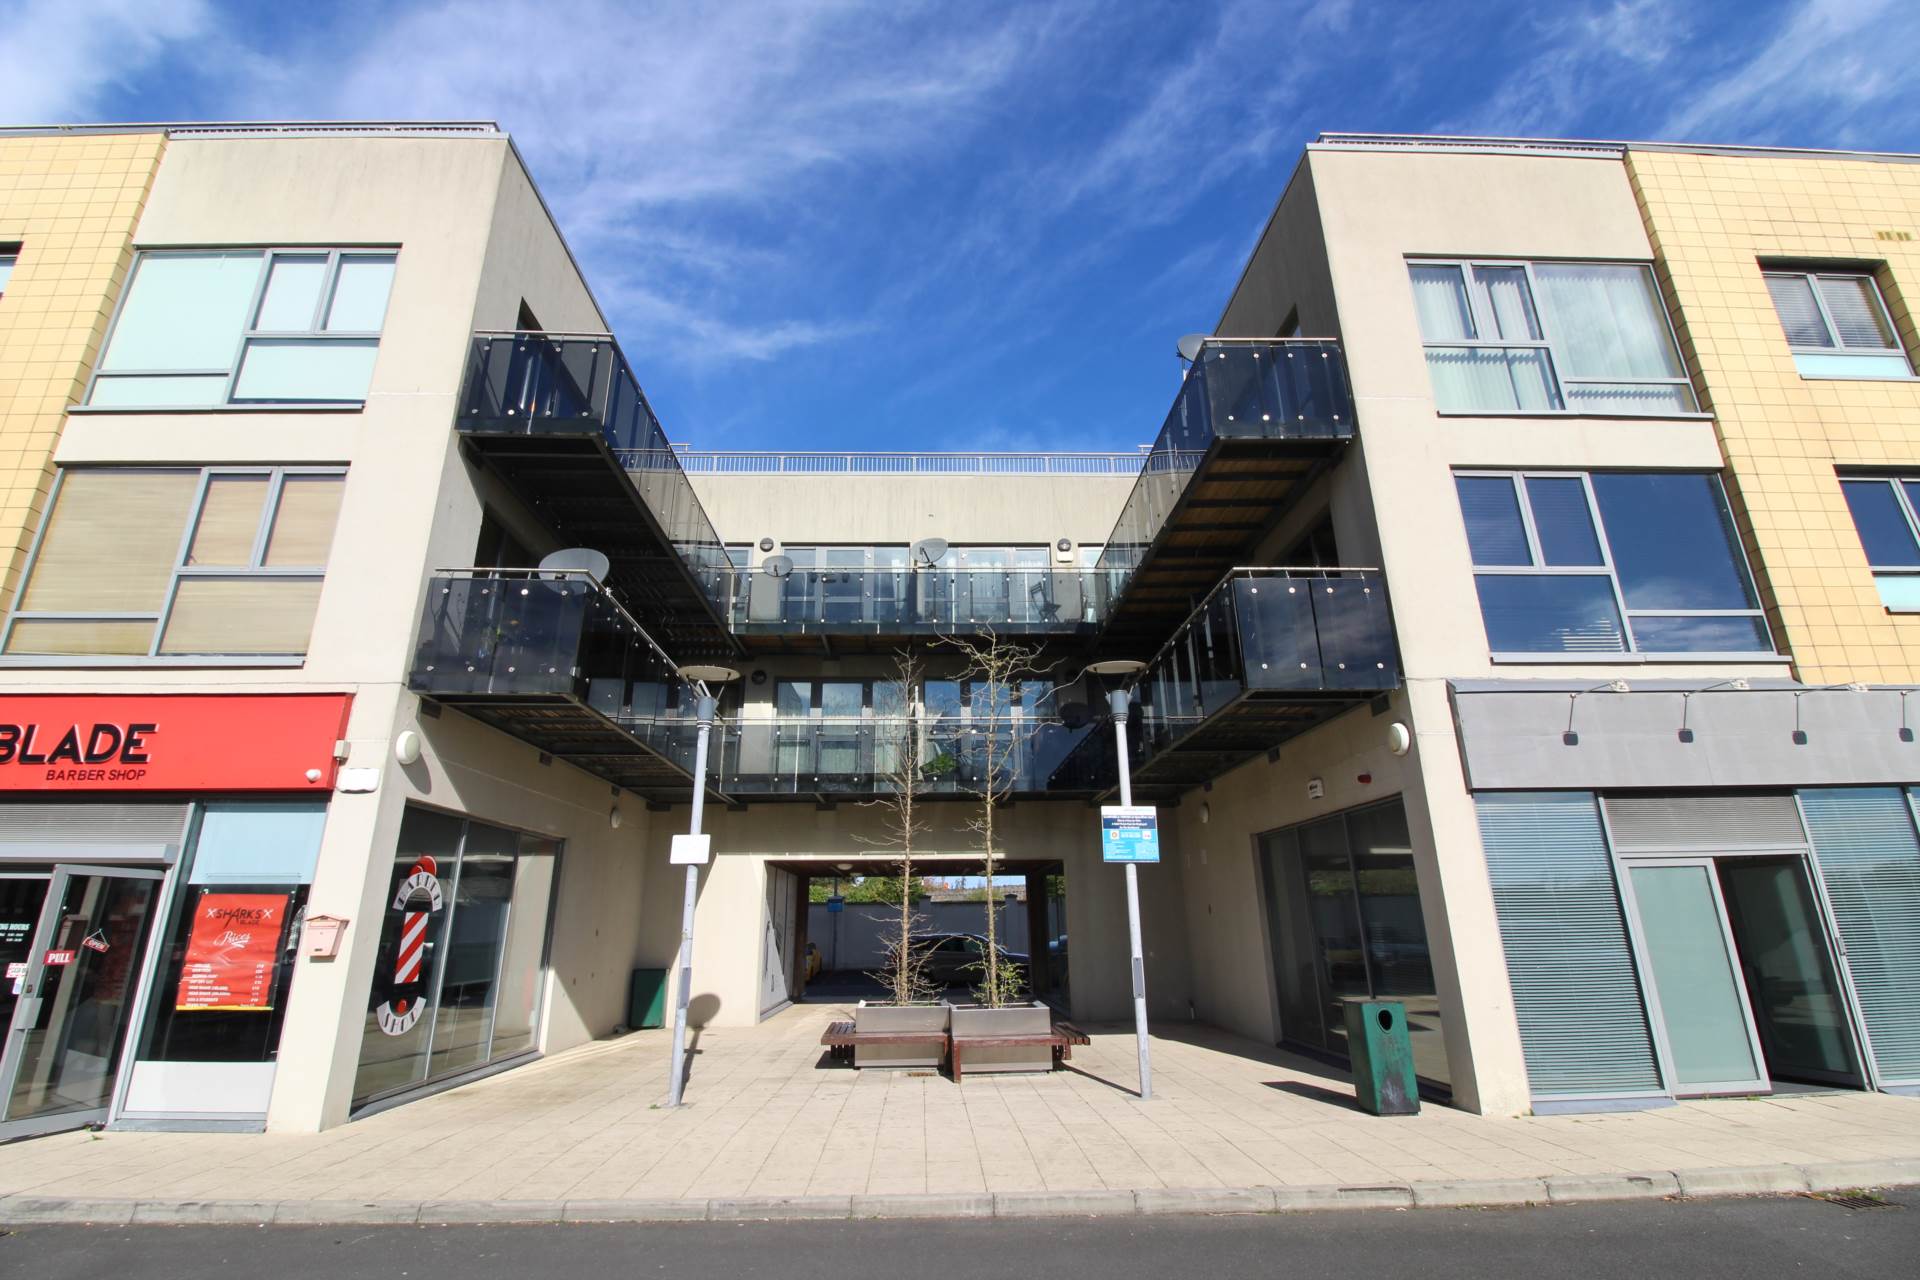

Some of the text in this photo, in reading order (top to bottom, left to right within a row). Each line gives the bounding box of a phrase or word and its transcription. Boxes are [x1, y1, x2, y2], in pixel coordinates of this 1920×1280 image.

[0, 723, 159, 765] BLADE
[46, 769, 146, 781] BARBER SHOP
[216, 907, 262, 930] SHARKS
[212, 931, 252, 949] Prices
[47, 952, 71, 963] PULL
